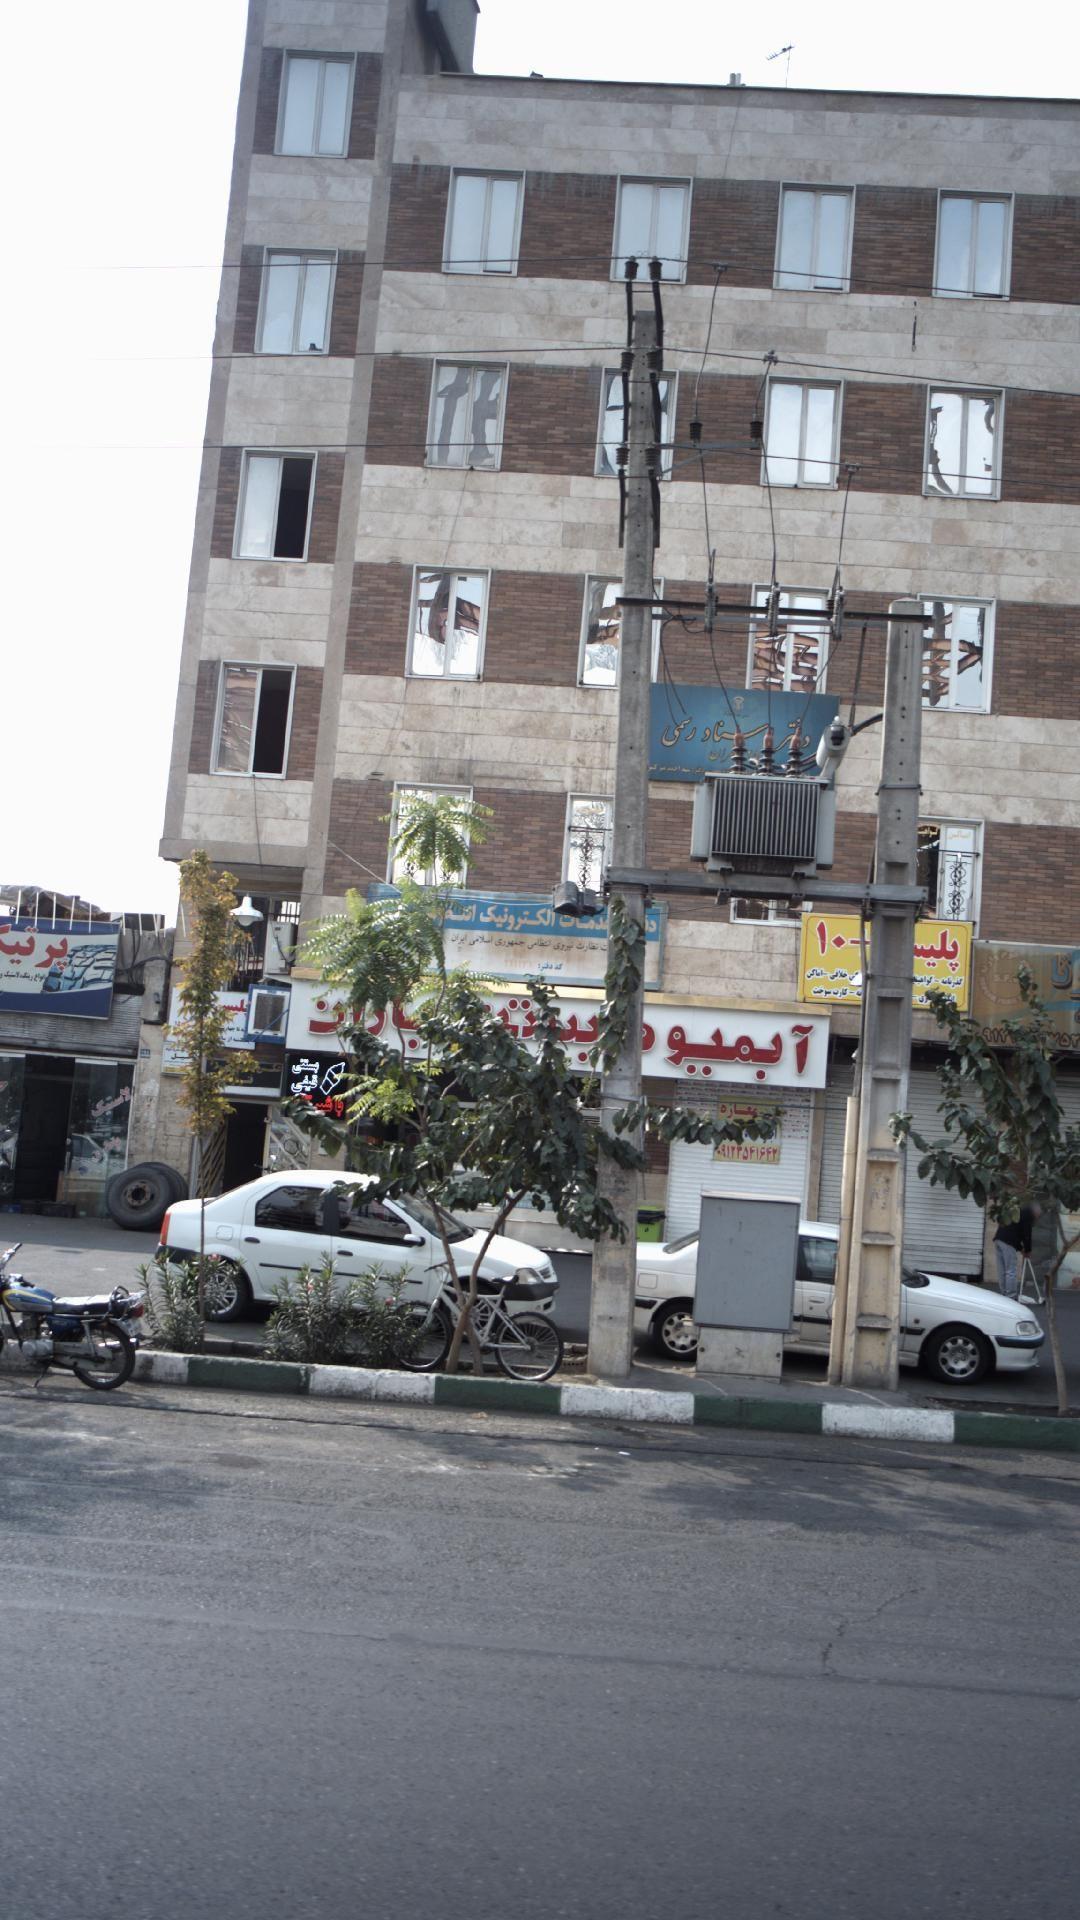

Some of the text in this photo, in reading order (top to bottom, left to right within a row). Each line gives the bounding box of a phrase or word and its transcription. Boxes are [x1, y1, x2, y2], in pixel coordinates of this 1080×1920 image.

[559, 911, 607, 931] دمات
[0, 923, 69, 972] پرتی
[291, 1058, 320, 1074] بستنی
[290, 1074, 318, 1093] قیفی
